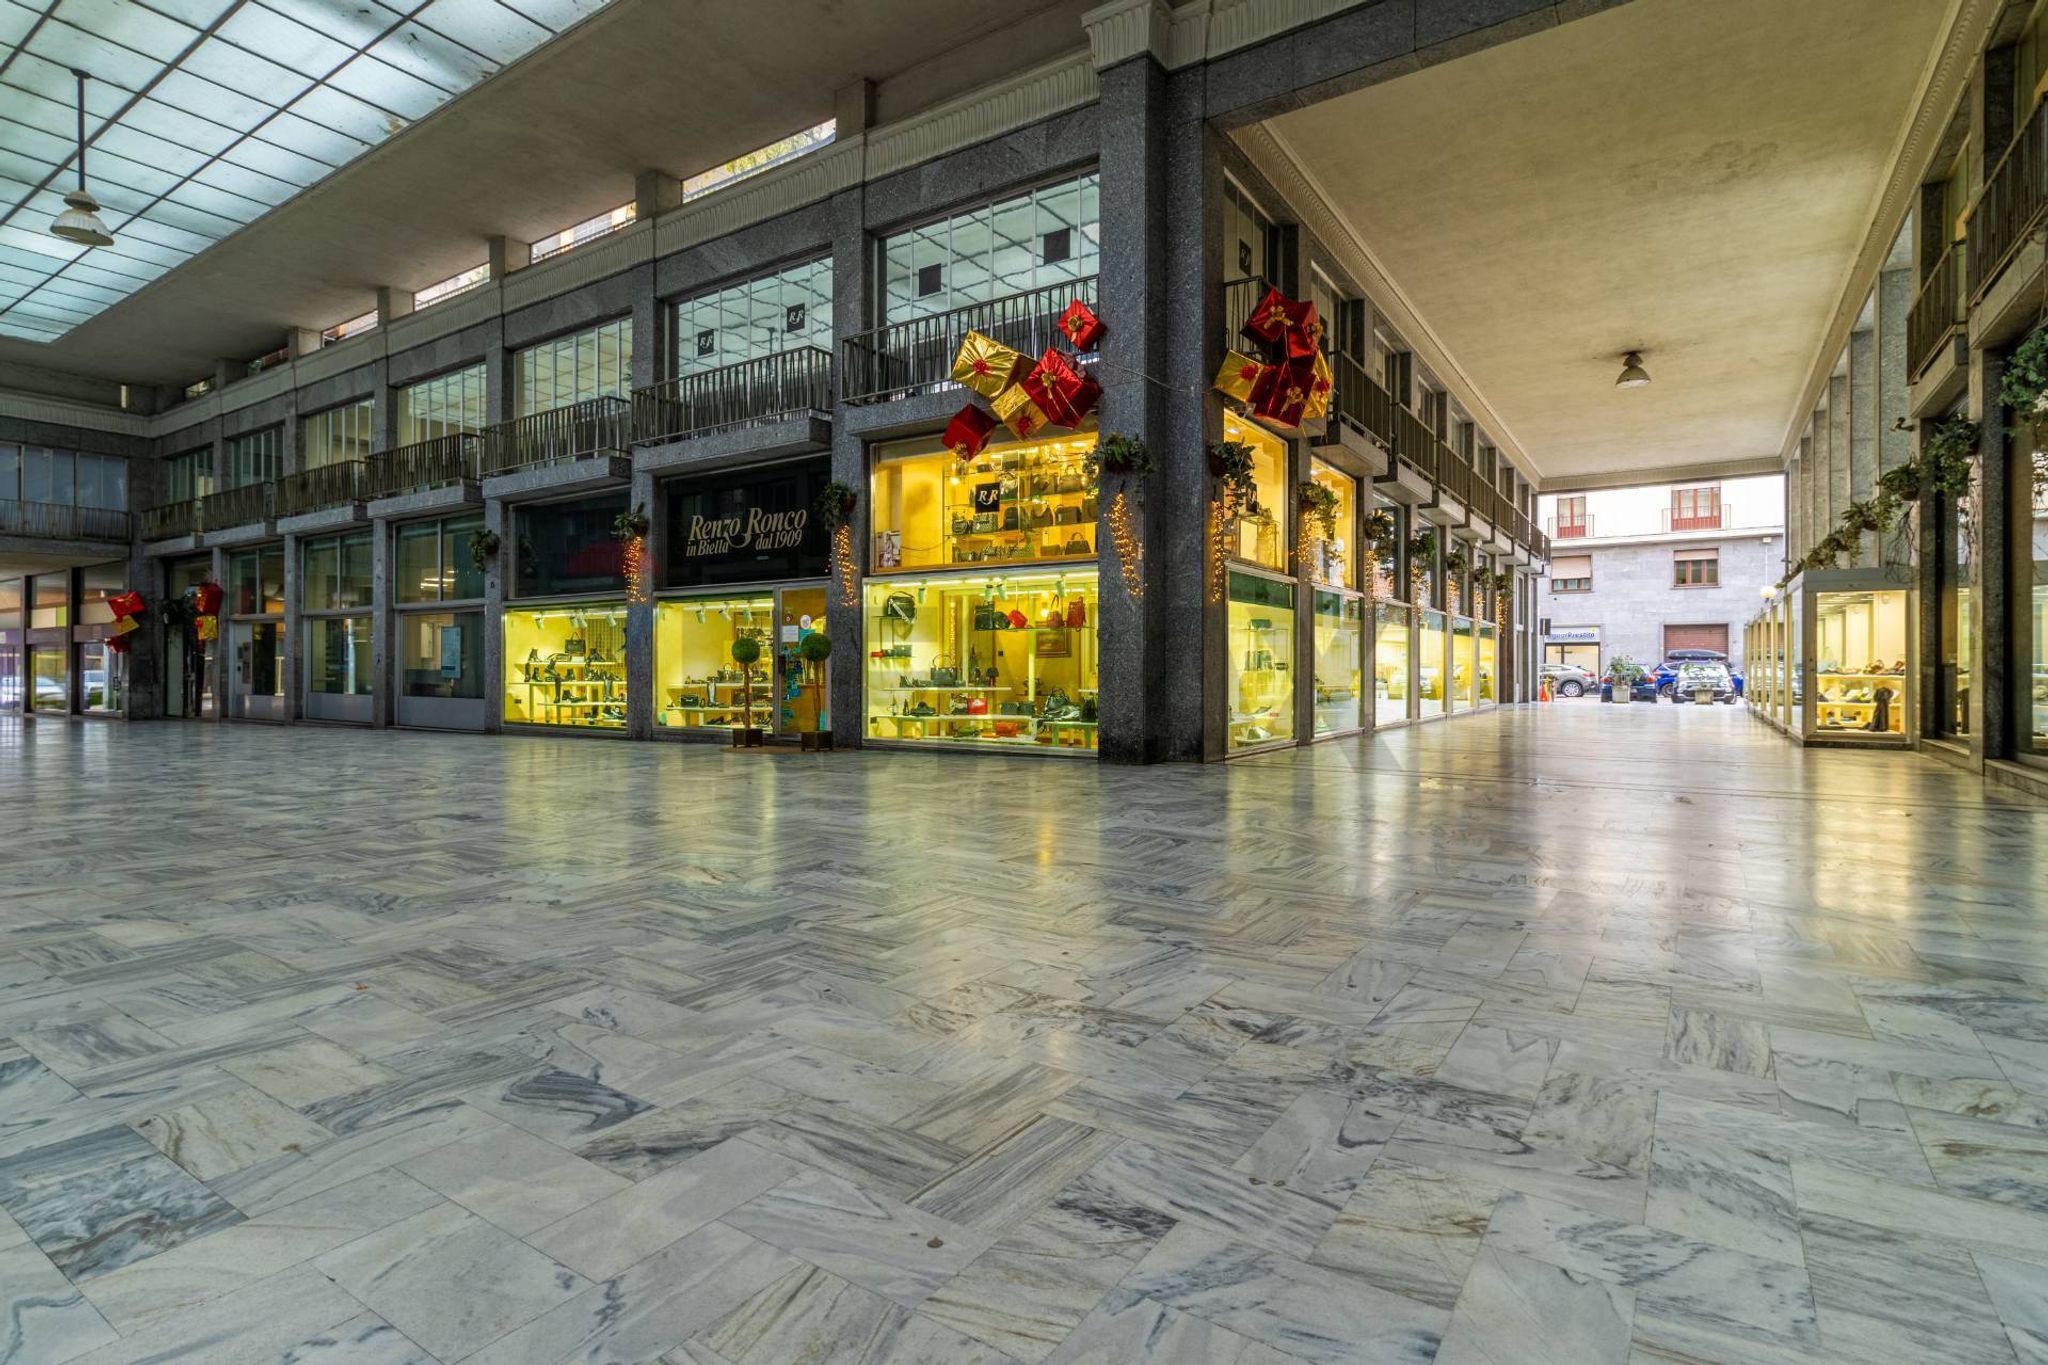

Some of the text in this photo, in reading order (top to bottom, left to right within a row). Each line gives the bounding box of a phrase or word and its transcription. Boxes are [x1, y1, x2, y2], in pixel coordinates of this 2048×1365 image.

[689, 507, 807, 545] Renzo Ronco
[686, 539, 729, 556] in Biella
[755, 528, 803, 550] dal 1909
